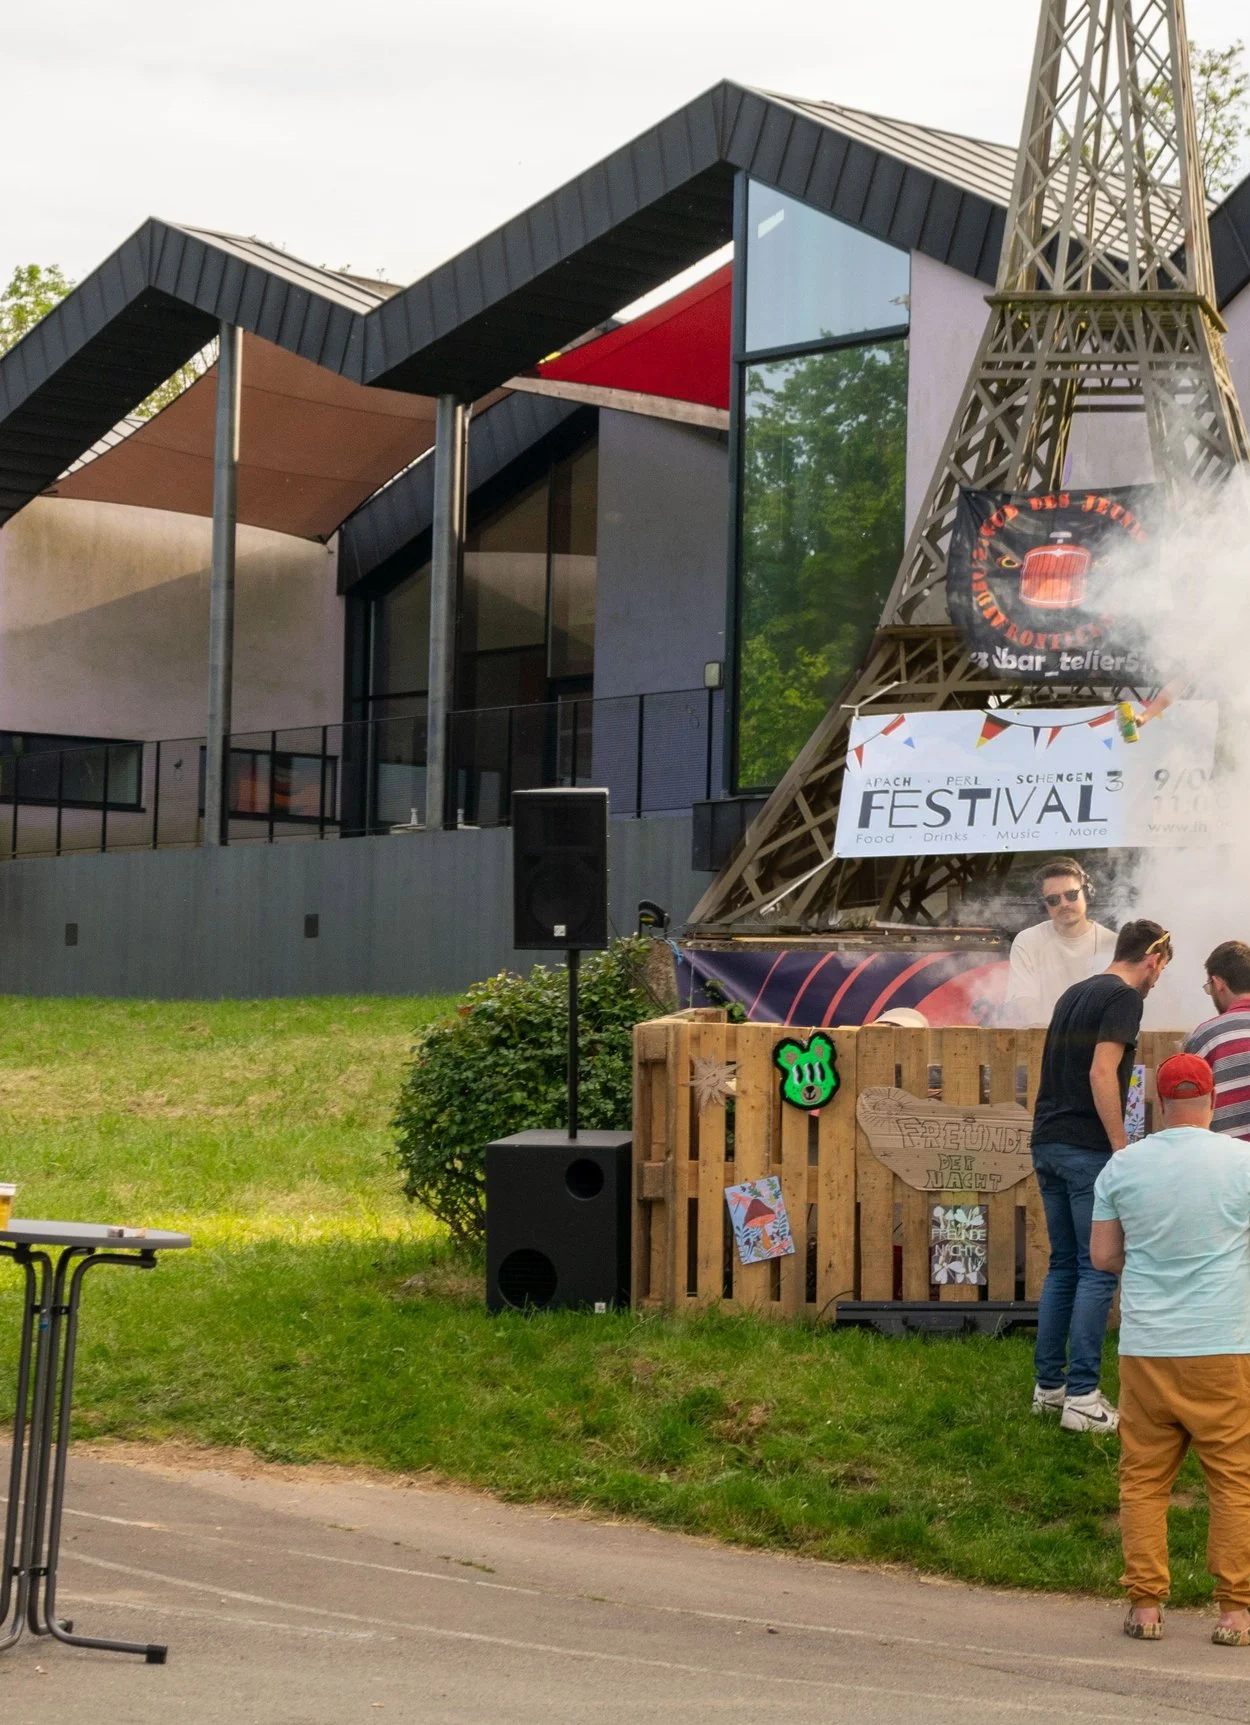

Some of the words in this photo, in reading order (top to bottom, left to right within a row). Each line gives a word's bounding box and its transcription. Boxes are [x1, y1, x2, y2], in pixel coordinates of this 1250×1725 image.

[865, 777, 912, 787] APACH
[946, 776, 981, 786] PERL
[1016, 771, 1093, 785] SCHENGEN
[857, 785, 1108, 829] FESTIVAL
[855, 833, 895, 844] Food
[923, 832, 968, 843] Drinks
[996, 829, 1041, 840] Music
[1069, 827, 1108, 837] More
[896, 1117, 1033, 1155] FREUNDE
[937, 1153, 976, 1171] DER
[923, 1169, 1002, 1190] NACHT
[931, 1228, 986, 1241] FREUNDE
